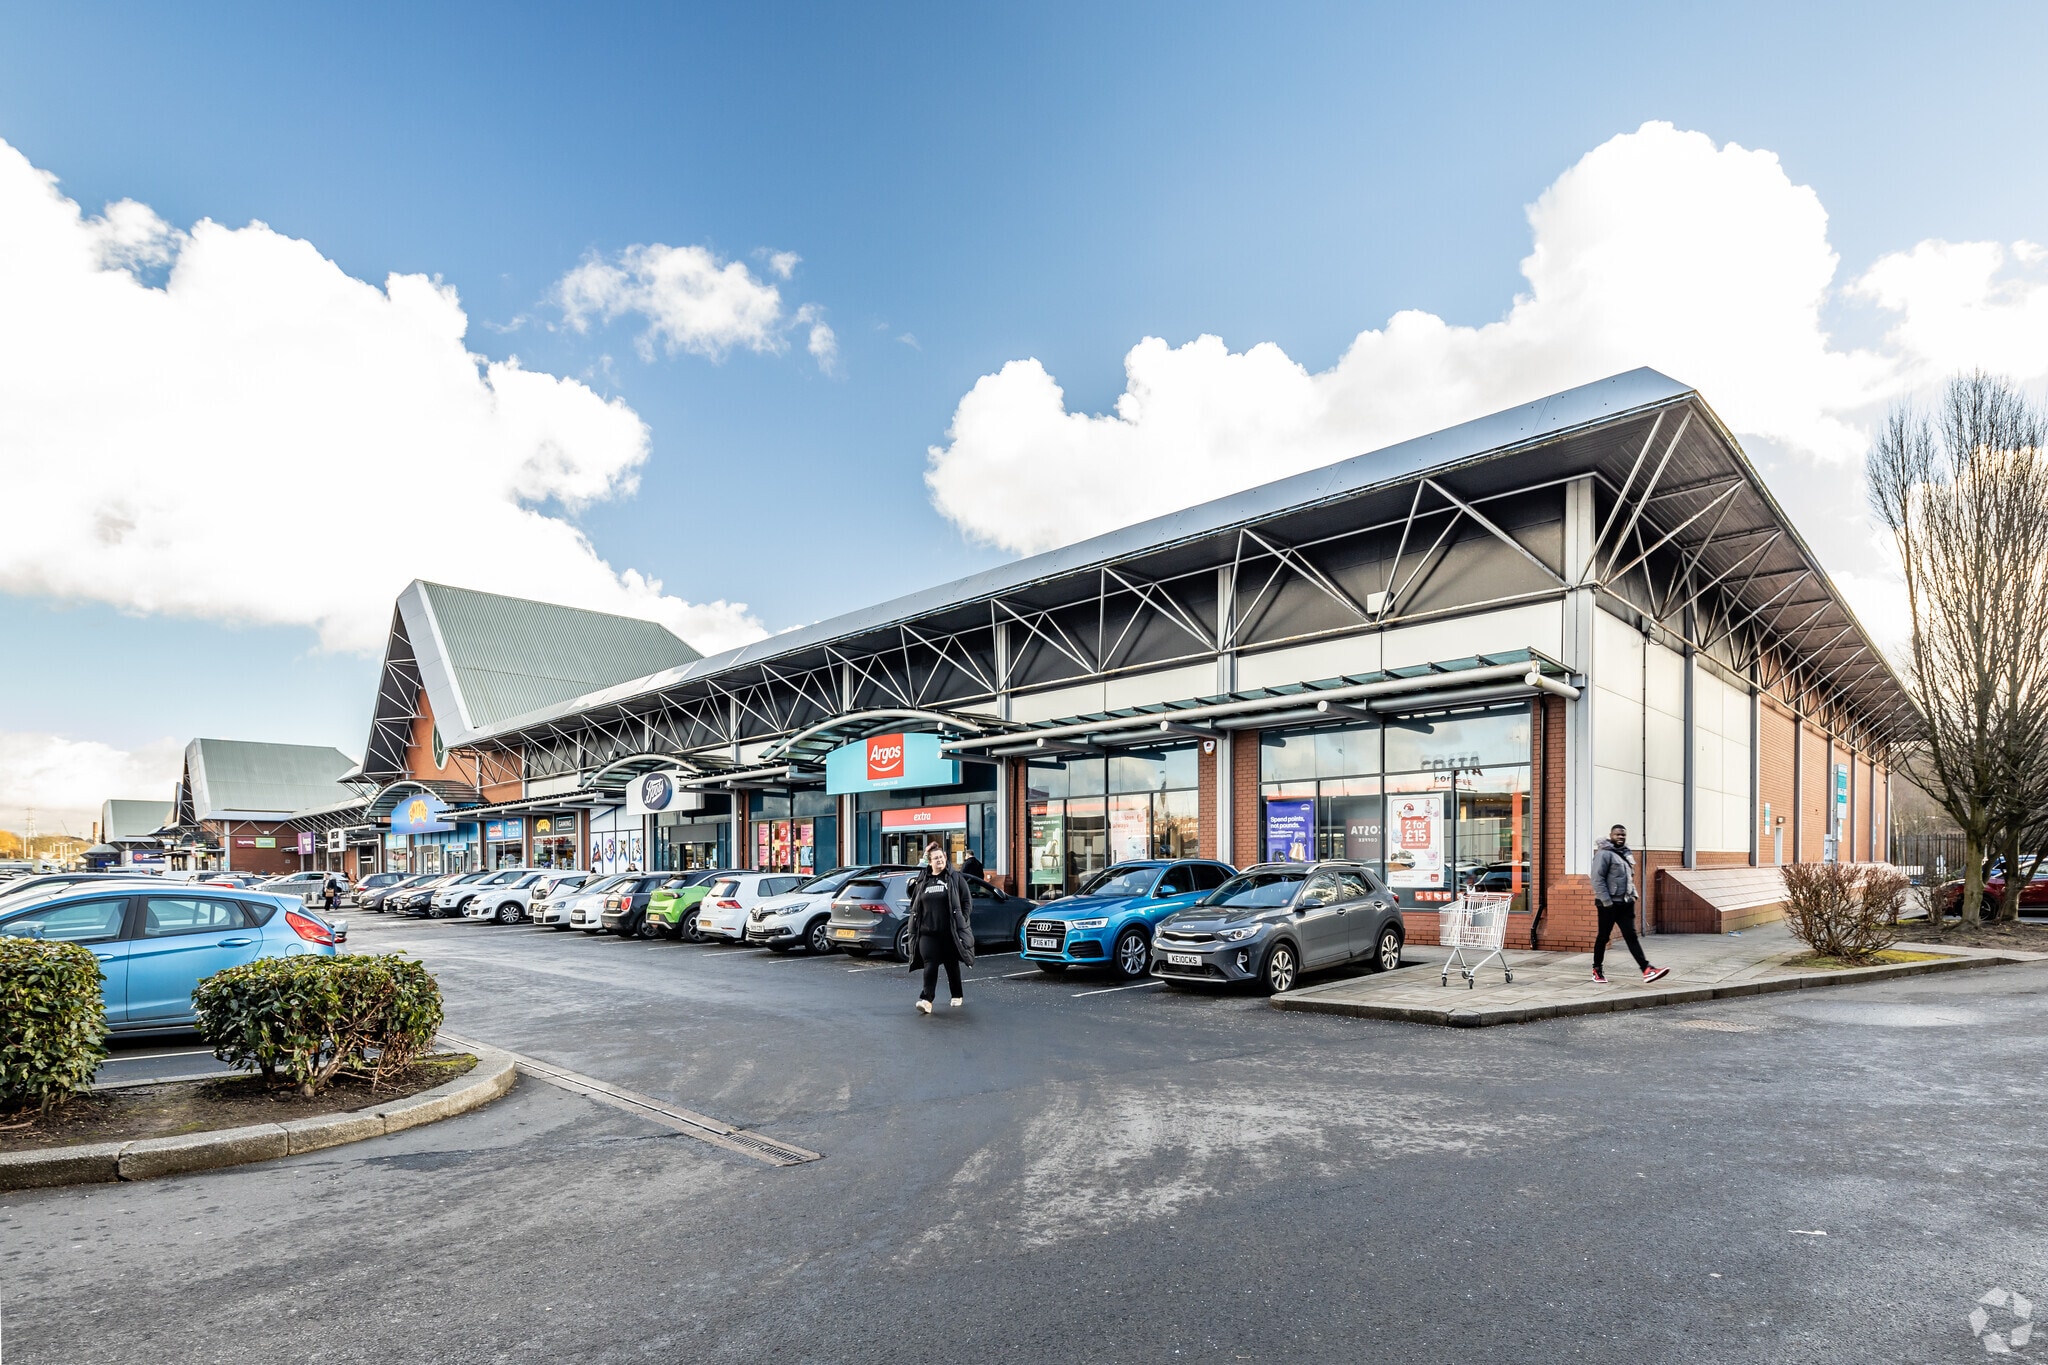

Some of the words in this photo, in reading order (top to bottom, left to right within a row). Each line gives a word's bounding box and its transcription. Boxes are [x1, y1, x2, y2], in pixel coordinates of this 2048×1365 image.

[869, 744, 902, 765] Argos
[644, 777, 664, 804] Boots
[913, 812, 932, 821] extra
[1405, 820, 1411, 829] 2
[1413, 820, 1427, 829] for
[1405, 829, 1427, 842] £15
